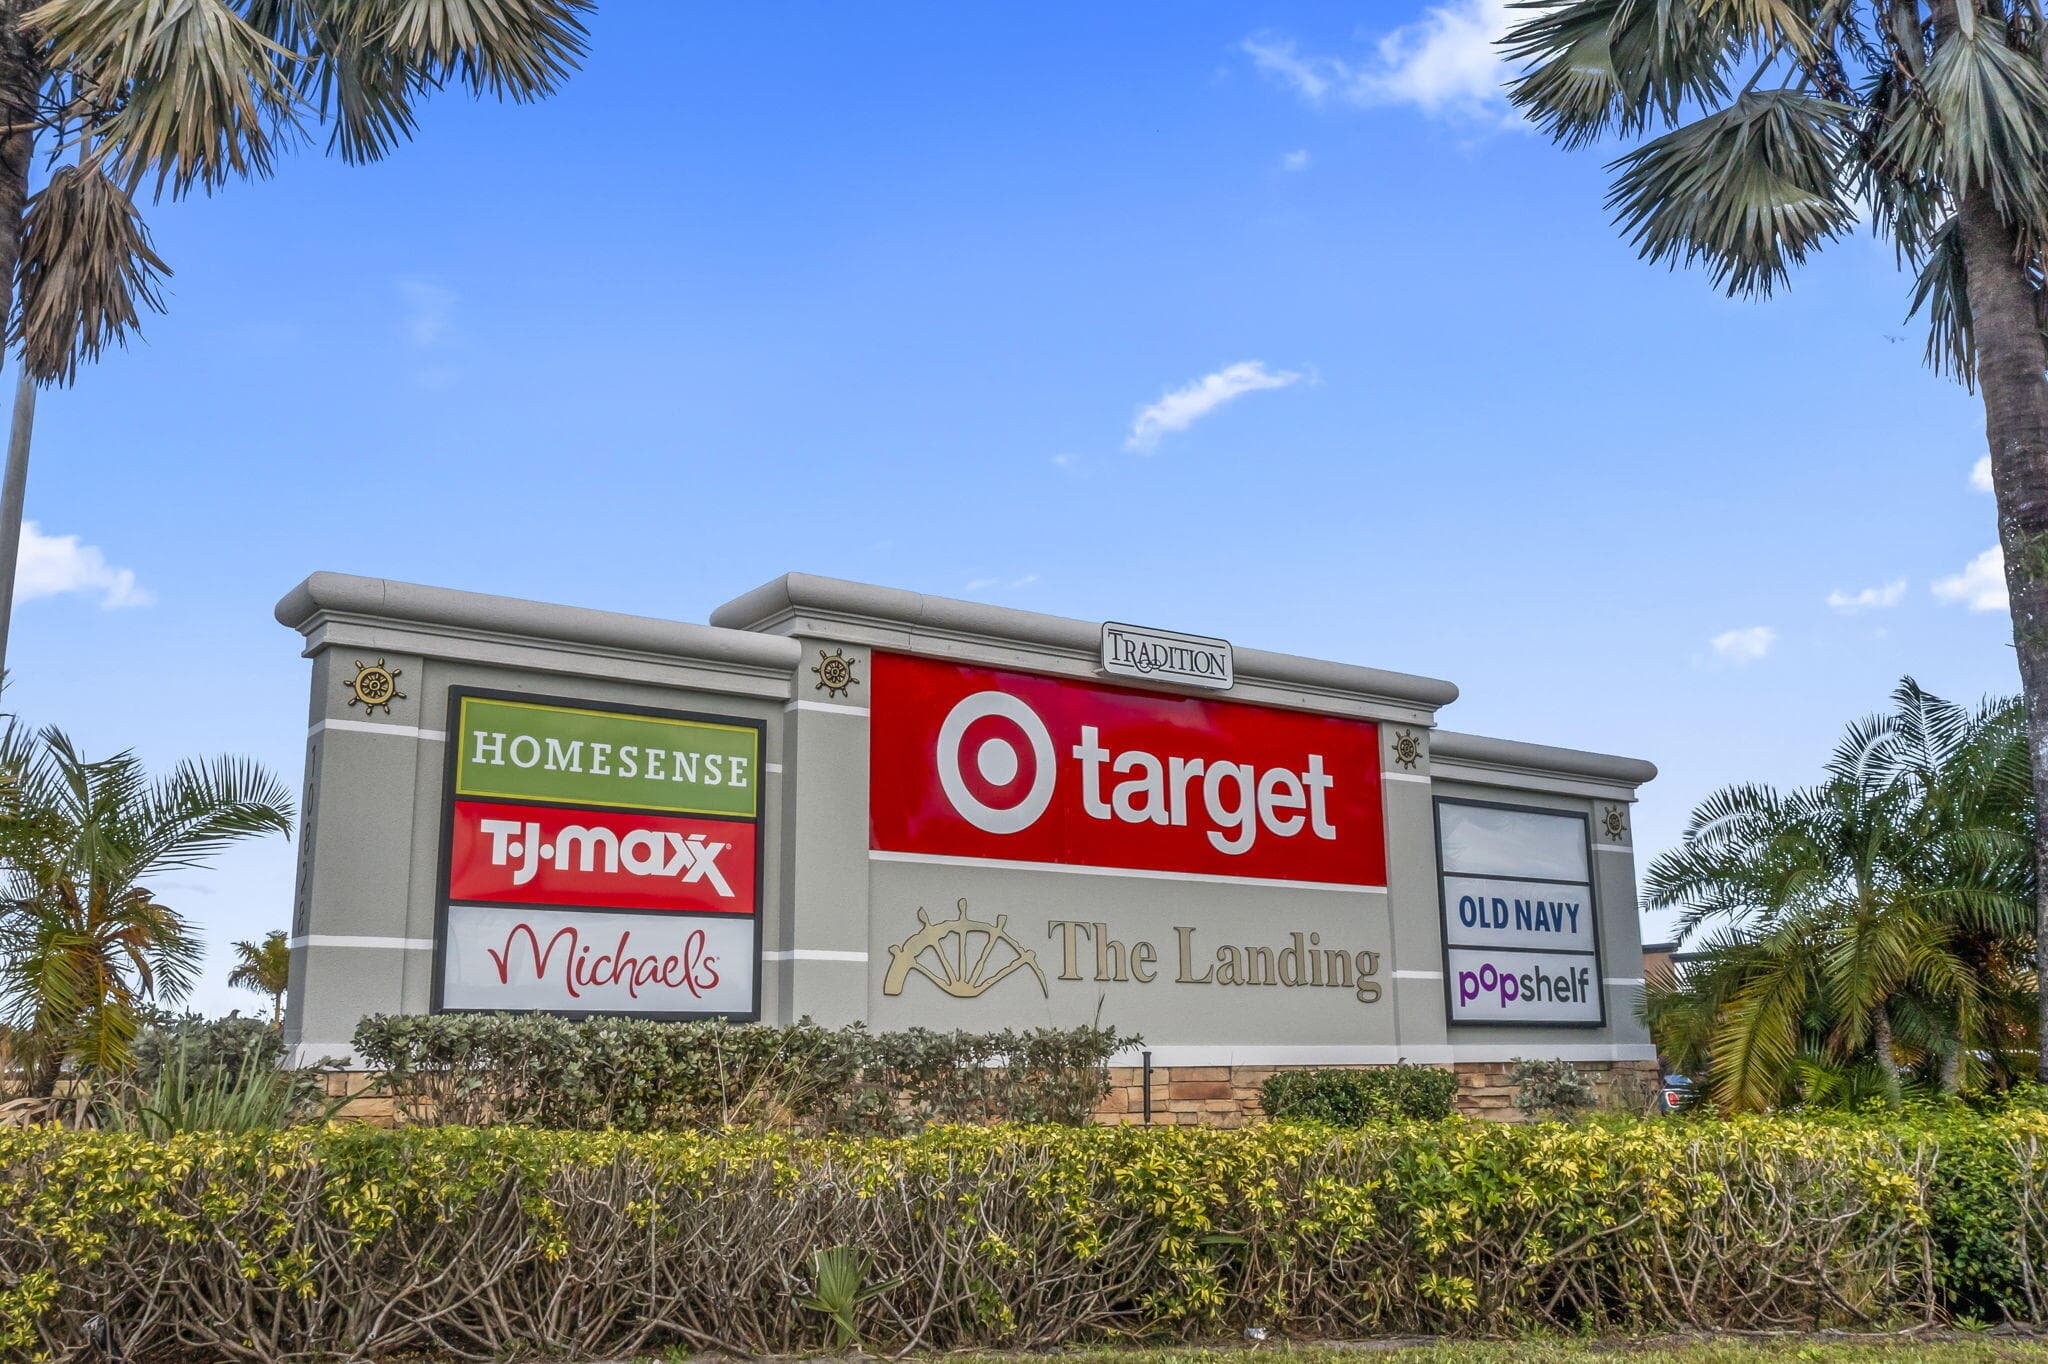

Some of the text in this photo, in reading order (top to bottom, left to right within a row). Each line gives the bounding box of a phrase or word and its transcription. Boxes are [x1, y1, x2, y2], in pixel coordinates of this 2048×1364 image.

[1108, 632, 1226, 676] TRADITION
[472, 730, 749, 788] HOMESENSE
[1072, 725, 1337, 856] target
[1459, 895, 1580, 934] OLD NAVY
[487, 923, 720, 999] Michaels
[1048, 920, 1382, 1004] The Landing
[1458, 963, 1590, 1008] popshelf
